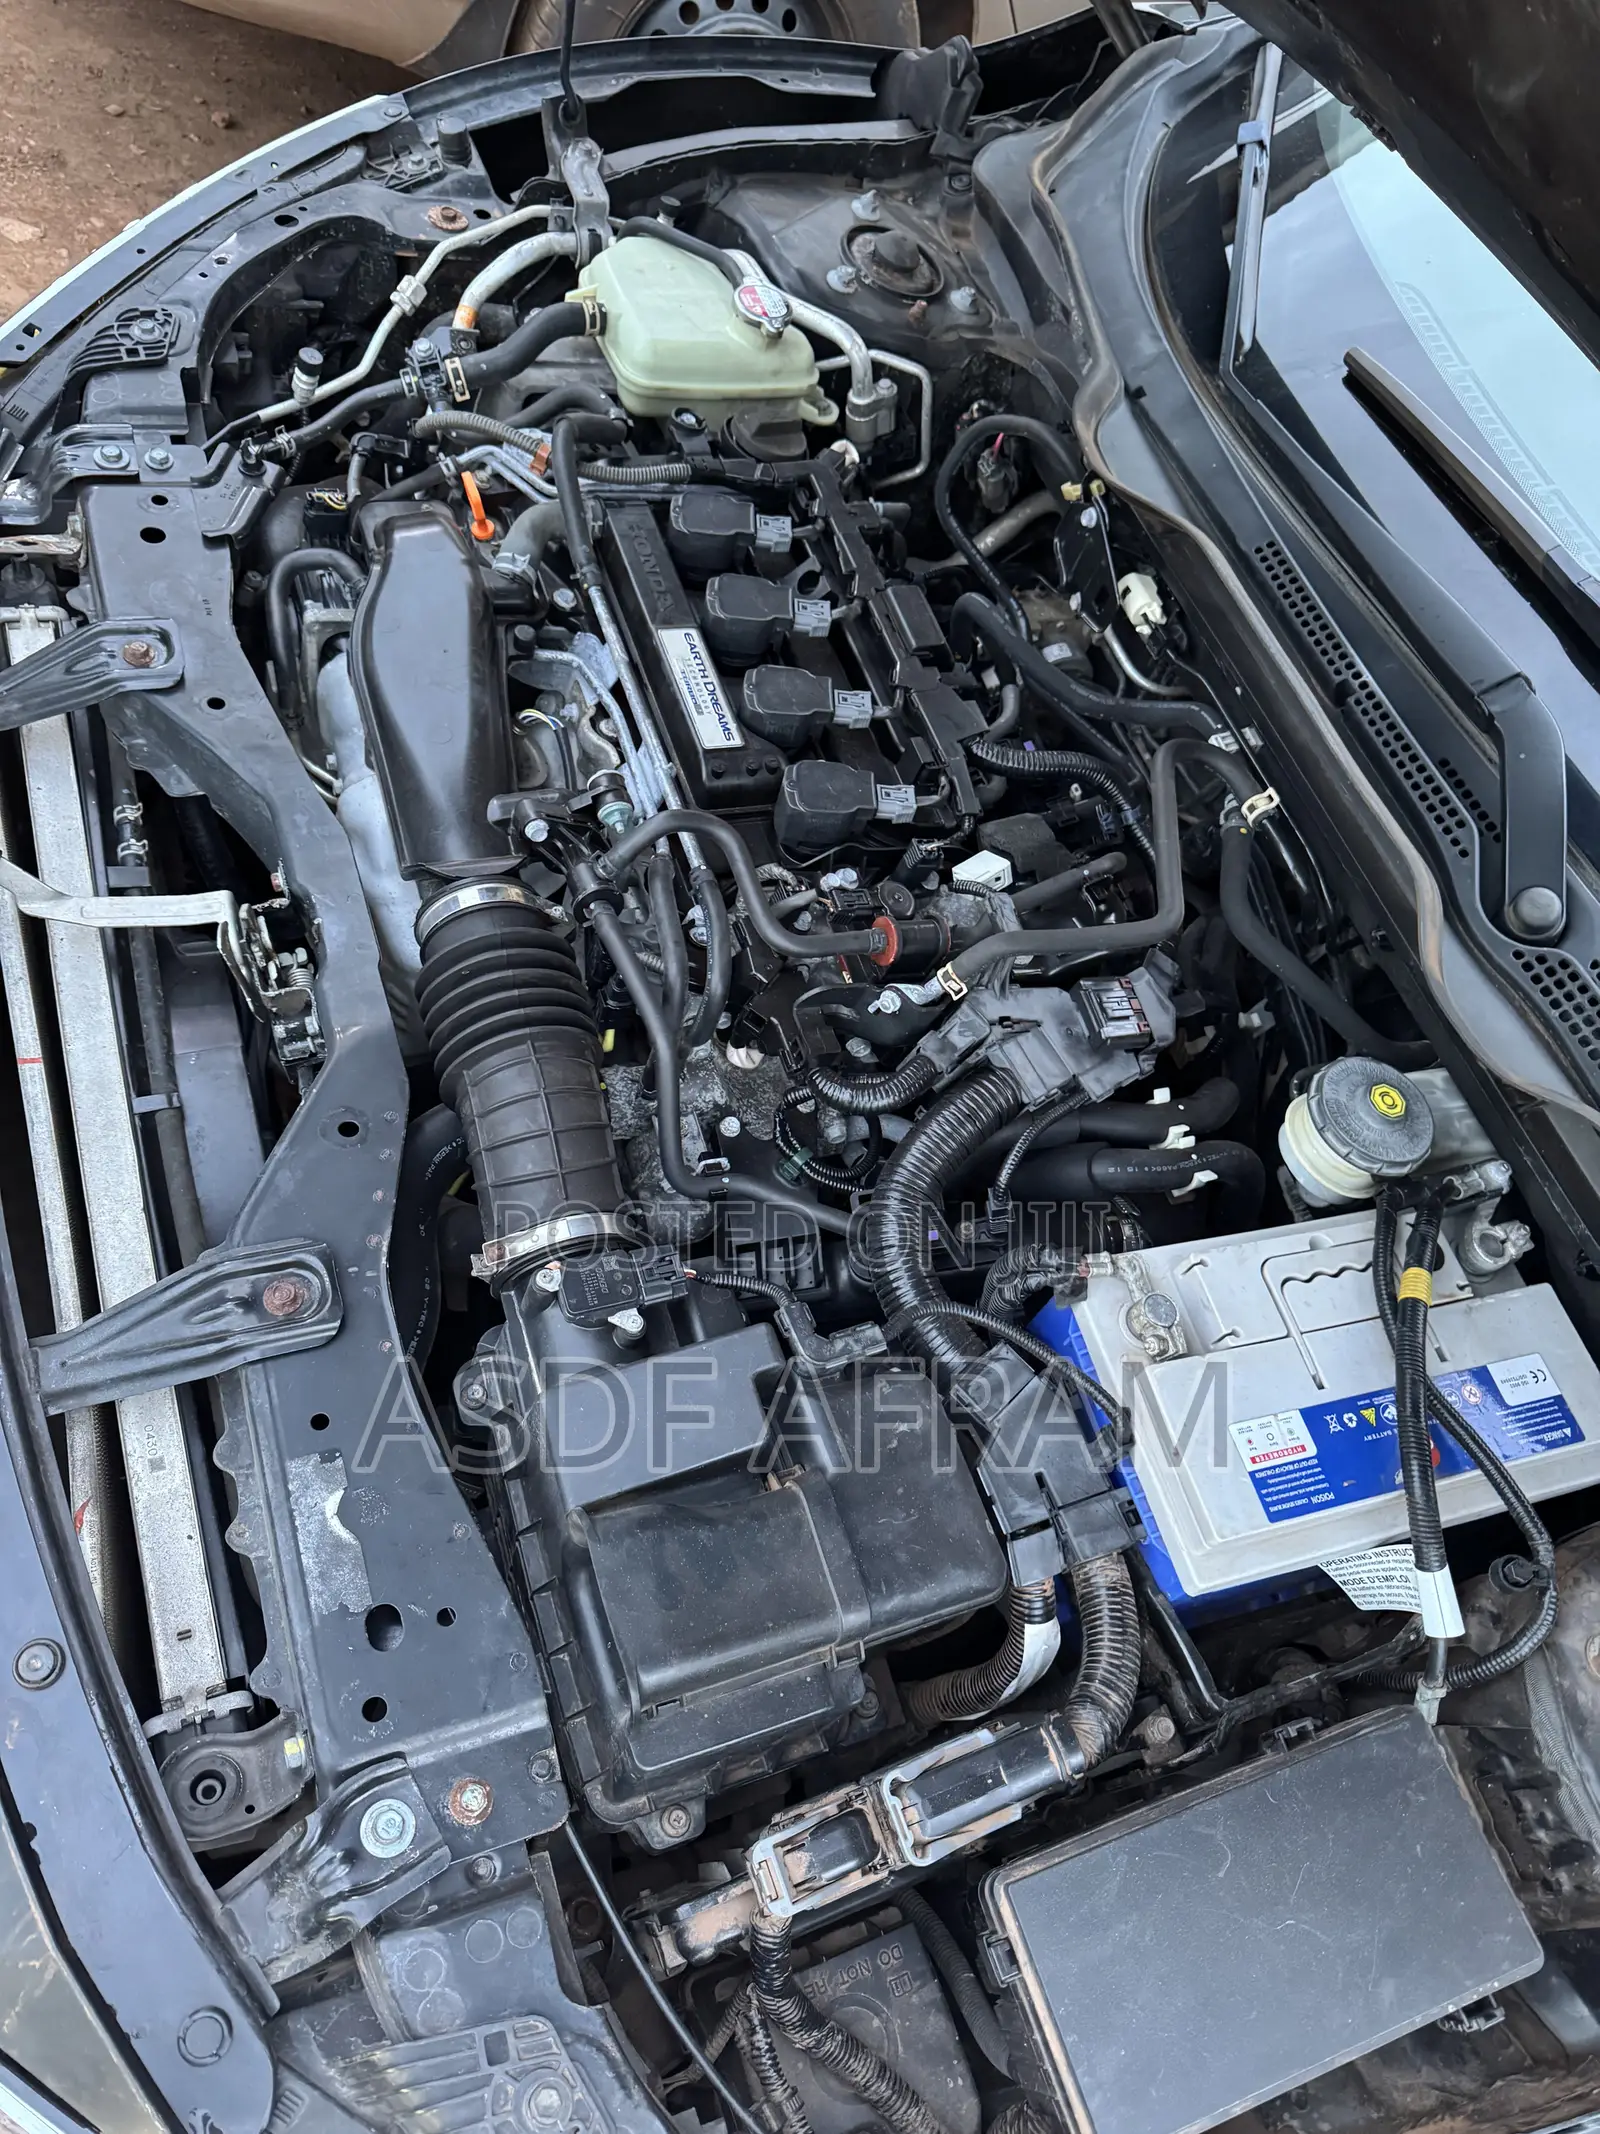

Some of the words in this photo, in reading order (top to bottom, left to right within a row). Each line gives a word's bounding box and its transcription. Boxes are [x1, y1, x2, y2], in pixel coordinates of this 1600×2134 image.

[627, 523, 675, 613] HONDA
[680, 671, 698, 706] TURBO
[684, 657, 712, 715] TECHNOLOGY
[684, 632, 710, 679] EARTH
[703, 681, 735, 742] DREAMS
[594, 1267, 609, 1294] DENSO
[143, 1423, 158, 1457] 0430
[1363, 1430, 1392, 1441] BATTERY
[1255, 1445, 1303, 1463] HYDROMETER
[1311, 1492, 1335, 1504] POISON
[1320, 1552, 1373, 1568] OPERATING
[1339, 1577, 1367, 1587] MODE
[1367, 1574, 1411, 1584] D'EMPLOI
[879, 1943, 904, 1967] DO
[839, 1959, 873, 1985] NOT
[803, 1978, 829, 2000] RE
